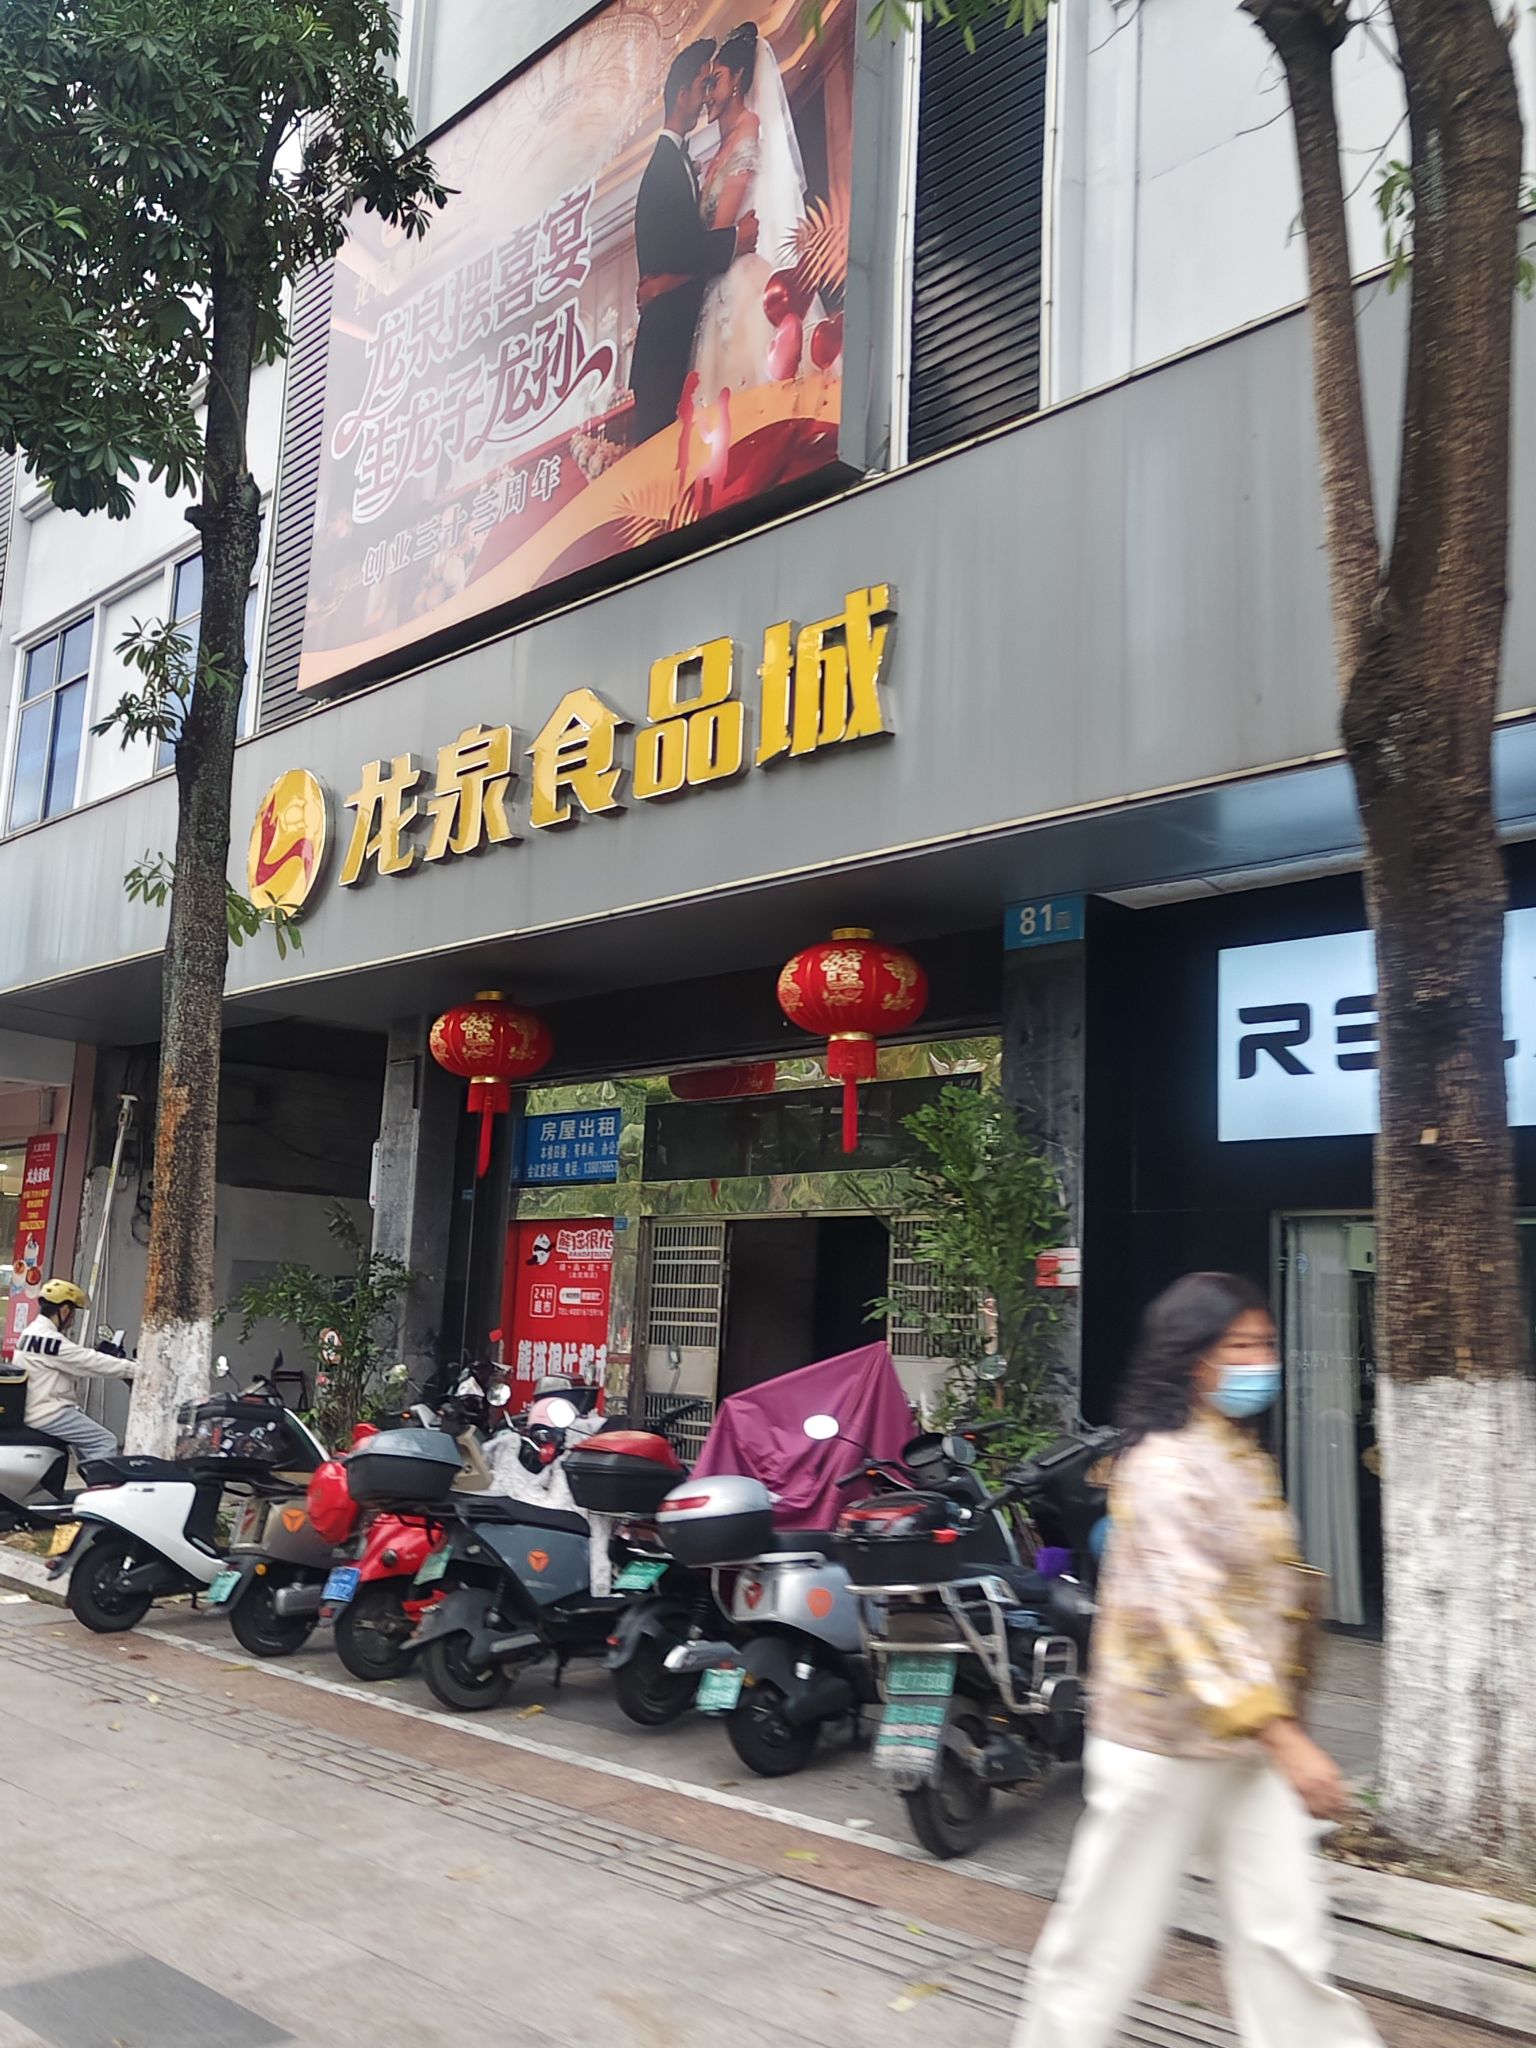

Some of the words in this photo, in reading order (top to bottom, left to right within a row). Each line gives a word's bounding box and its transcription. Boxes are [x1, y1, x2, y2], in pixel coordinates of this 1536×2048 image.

[338, 583, 898, 888] 龙泉食品城
[540, 1116, 616, 1141] 房屋出租
[556, 1229, 613, 1251] 熊猫很忙
[534, 1287, 553, 1299] 24H
